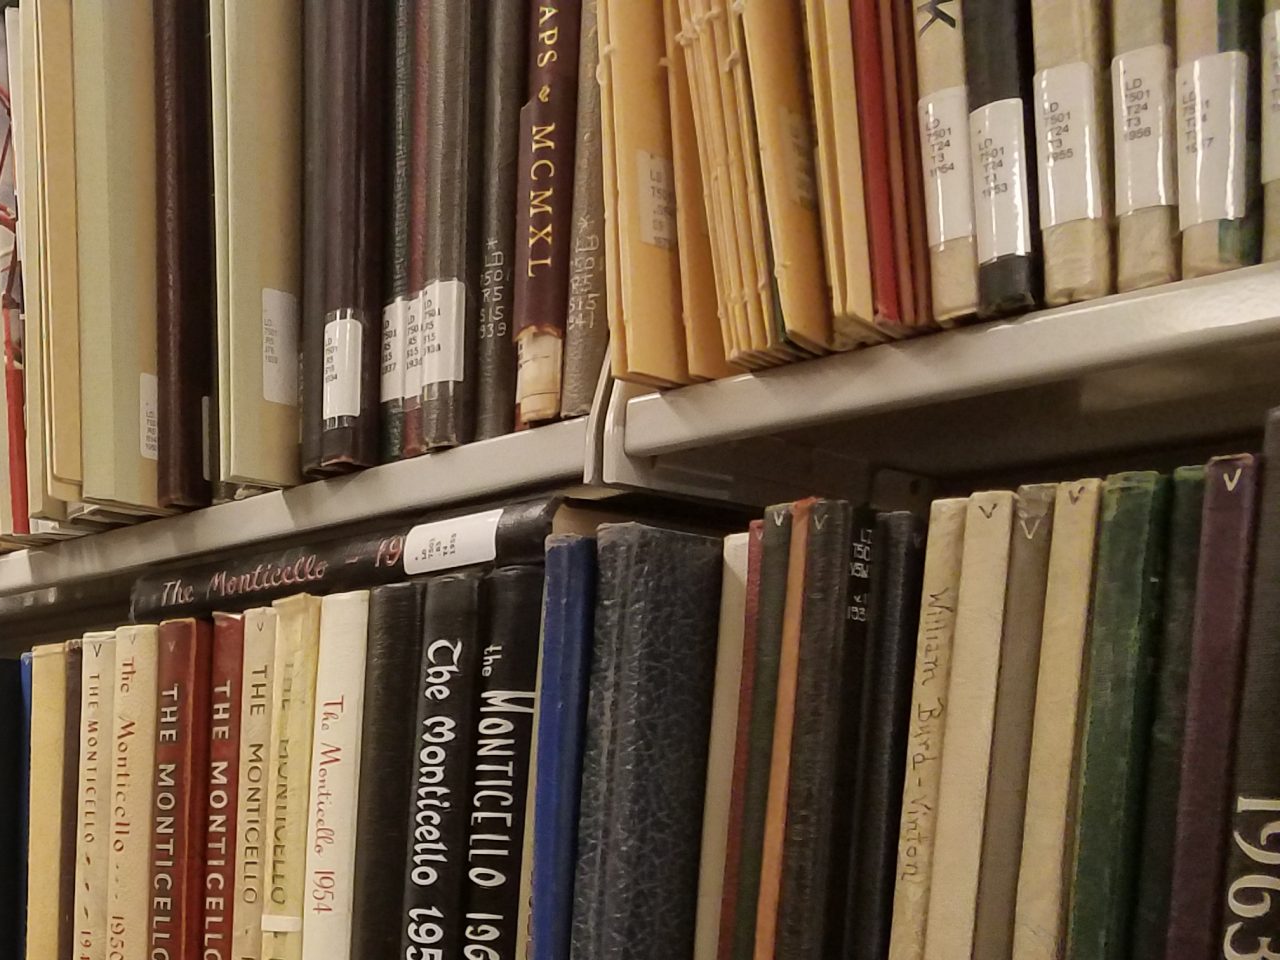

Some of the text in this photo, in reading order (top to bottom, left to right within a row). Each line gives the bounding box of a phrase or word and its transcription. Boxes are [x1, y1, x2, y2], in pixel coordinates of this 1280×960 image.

[527, 122, 556, 278] MCMXL
[160, 580, 195, 607] The
[206, 553, 329, 599] Monticello
[120, 656, 137, 694] The
[424, 638, 463, 701] The
[482, 643, 502, 678] the
[922, 586, 955, 687] William
[88, 672, 100, 709] THE
[160, 683, 179, 743] THE
[210, 679, 232, 741] THE
[250, 664, 268, 717] THE
[911, 697, 945, 771] Byrd
[83, 719, 99, 845] MONTICELLO
[112, 715, 137, 854] Monticello
[313, 694, 346, 915] The Monticello 1954
[411, 715, 458, 887] Monticello
[468, 689, 537, 888] MONTICELLO
[242, 743, 264, 905] MONTICELLO
[900, 793, 932, 881] Vinton
